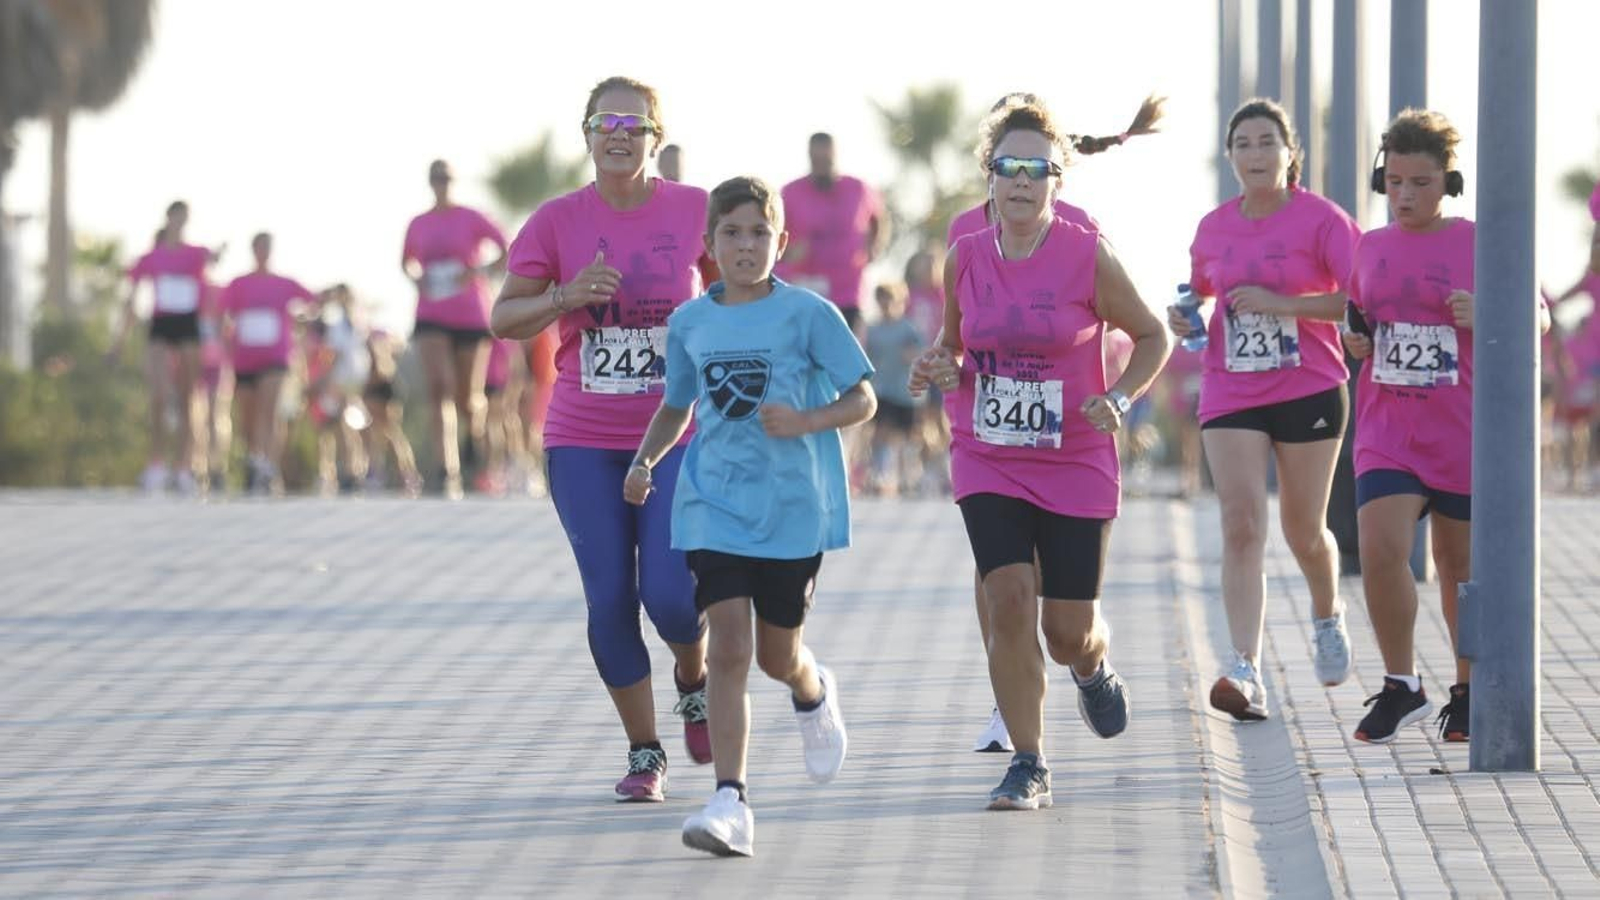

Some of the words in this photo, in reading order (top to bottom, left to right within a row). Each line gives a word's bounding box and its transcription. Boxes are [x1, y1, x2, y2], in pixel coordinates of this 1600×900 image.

[1236, 325, 1285, 358] 231
[1385, 342, 1443, 371] 423
[594, 347, 657, 378] 242
[984, 398, 1048, 433] 340
